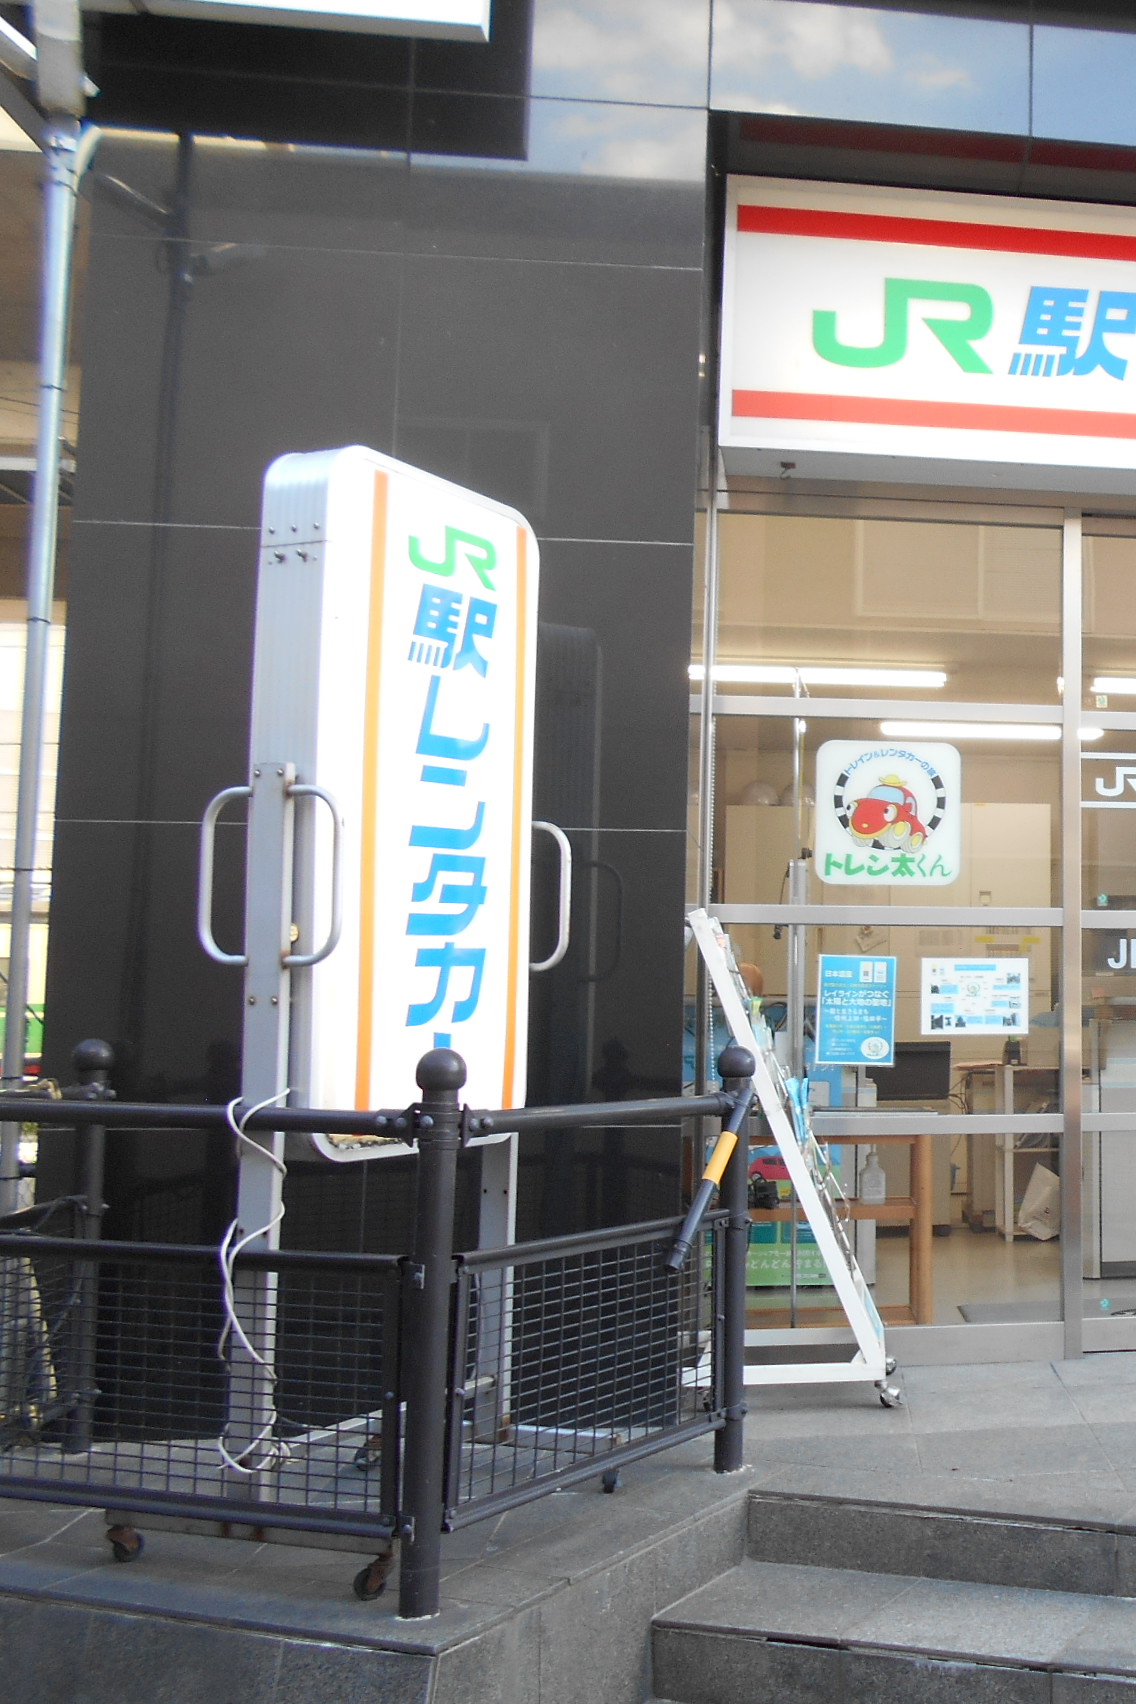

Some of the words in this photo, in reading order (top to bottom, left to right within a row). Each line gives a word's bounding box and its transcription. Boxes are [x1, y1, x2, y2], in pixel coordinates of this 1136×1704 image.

[825, 852, 952, 878] トレン太くん
